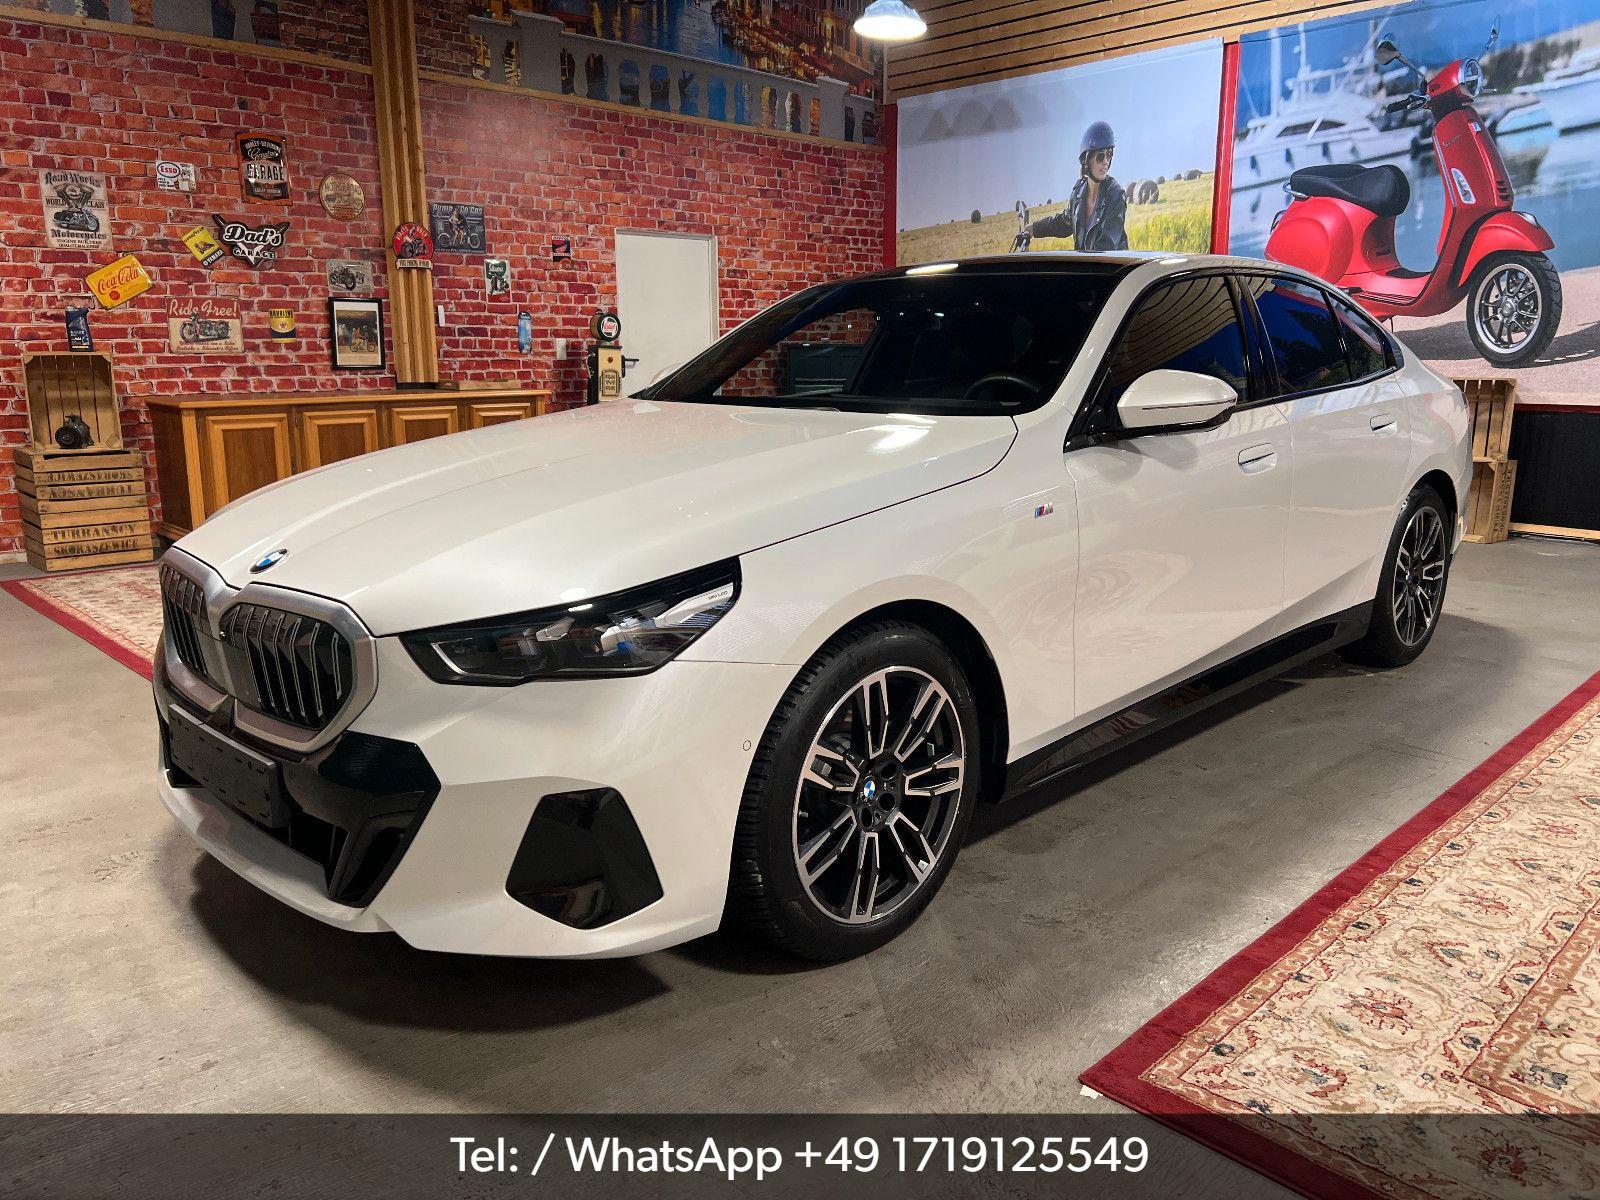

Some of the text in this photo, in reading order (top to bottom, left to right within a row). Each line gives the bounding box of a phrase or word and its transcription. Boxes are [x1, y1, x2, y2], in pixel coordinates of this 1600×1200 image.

[45, 171, 68, 185] Road
[247, 164, 284, 181] GARAGE
[46, 198, 67, 206] WORLD
[50, 228, 107, 239] Motorcycles
[224, 224, 281, 245] Dad's
[207, 250, 224, 264] YAMAHA
[232, 248, 275, 259] GARAGE
[169, 299, 237, 317] Ride Free!
